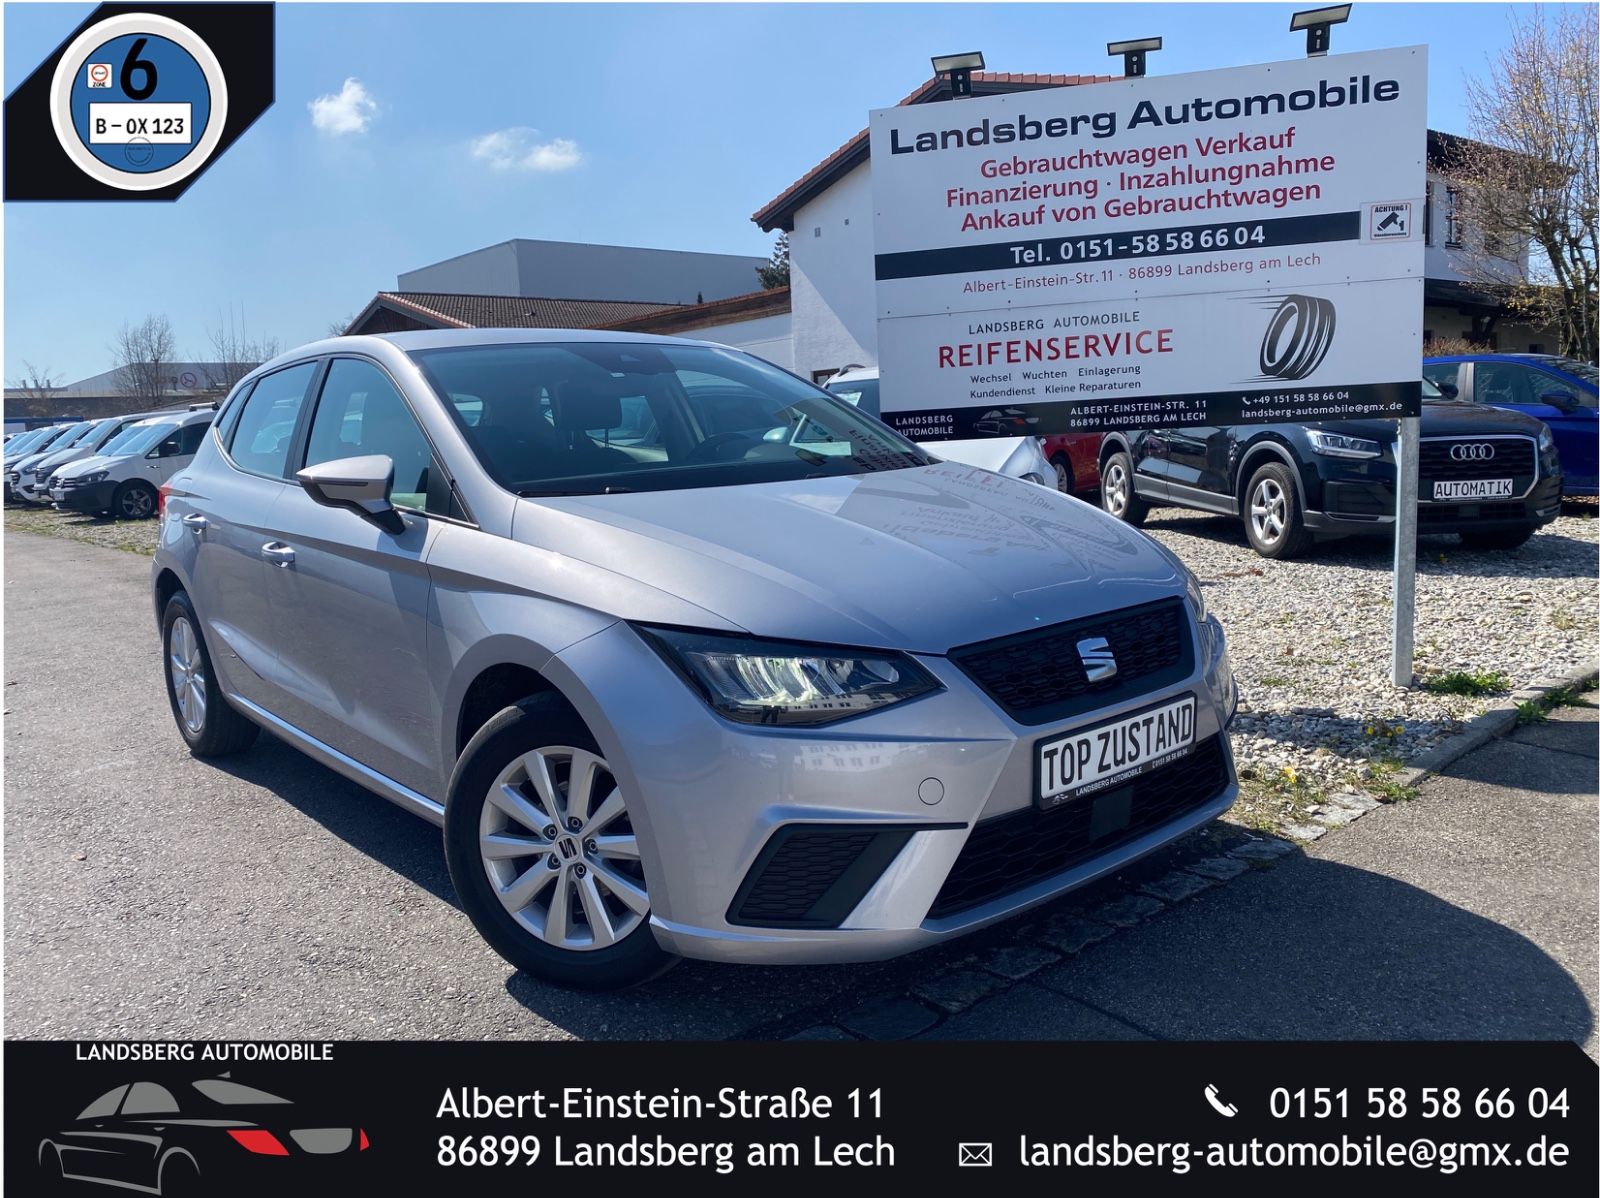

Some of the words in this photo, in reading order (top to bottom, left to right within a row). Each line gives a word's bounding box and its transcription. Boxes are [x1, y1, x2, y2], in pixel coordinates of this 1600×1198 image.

[890, 111, 1117, 155] Landsberg
[1127, 75, 1400, 129] Automobile
[980, 143, 1188, 178] Gebrauchtwagen
[1195, 126, 1296, 157] Verkauf
[946, 178, 1098, 208] Finanzierung
[1119, 155, 1335, 191] Inzahlungnahme
[961, 204, 1045, 232] Ankauf
[1051, 206, 1096, 223] von
[1103, 184, 1321, 218] Gebrauchtwagen
[1010, 243, 1051, 265] Tel.
[1166, 231, 1194, 251] 58
[1200, 228, 1229, 248] 66
[1234, 225, 1266, 245] 04
[1128, 264, 1172, 280] 86899
[1178, 258, 1253, 276] Landsberg
[1259, 259, 1281, 270] am
[1287, 252, 1321, 267] Lech
[968, 319, 1044, 335] LANDSBERG
[1053, 311, 1140, 329] AUTOMOBILE
[938, 328, 1174, 369] REIFENSERVICE
[970, 373, 1012, 384] Wechsel
[1022, 369, 1068, 381] Wuchten
[1078, 364, 1142, 378] Einlagerung
[969, 386, 1036, 399] Kundendienst
[1045, 384, 1076, 395] Kleine
[1079, 380, 1142, 394] Reparaturen
[1253, 396, 1271, 405] +49
[1274, 394, 1291, 404] 151
[1293, 393, 1305, 403] 58
[1308, 392, 1320, 402] 58
[1322, 391, 1335, 401] 66
[1336, 390, 1350, 400] 04
[895, 414, 954, 426] LANDSBERG
[1070, 401, 1190, 416] ALBERT-EINSTEIN-STR.
[1195, 400, 1207, 409] 11
[1070, 417, 1100, 428] 86899
[1103, 413, 1161, 426] LANDSBERG
[1163, 413, 1178, 422] AM
[1181, 411, 1207, 421] LECH
[1241, 401, 1404, 419] landsberg-automobile@gmx.de
[1435, 480, 1512, 497] AUTOMATIK
[1043, 738, 1092, 791] TOP
[1097, 702, 1193, 775] ZUSTAND
[1075, 778, 1110, 797] LANDSBERG
[1109, 766, 1143, 785] AUTOMOBILE
